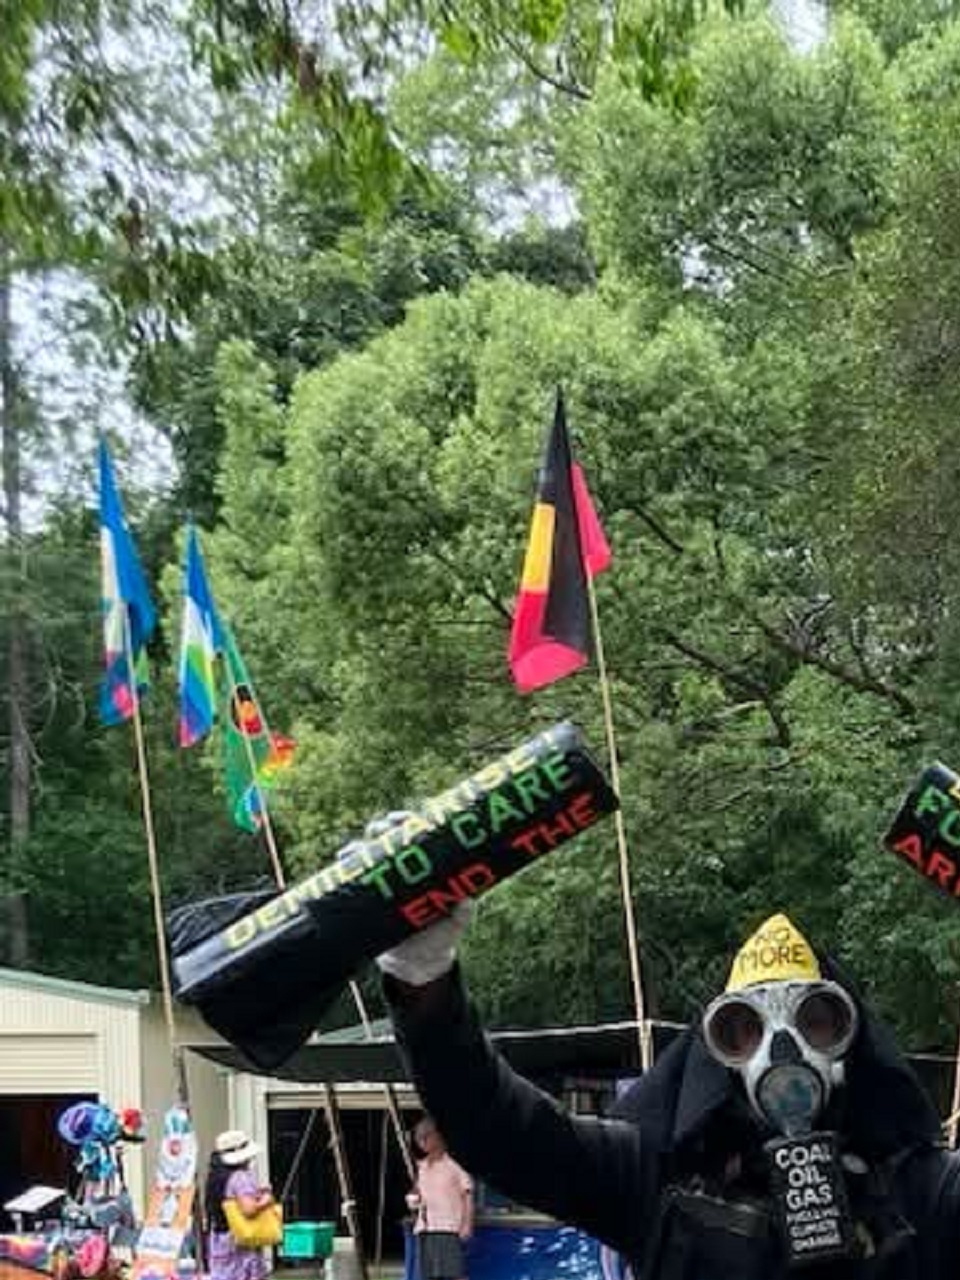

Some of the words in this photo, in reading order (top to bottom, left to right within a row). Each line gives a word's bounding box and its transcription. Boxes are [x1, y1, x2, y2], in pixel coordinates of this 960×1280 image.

[361, 846, 432, 898] TO
[450, 750, 575, 851] CARE
[402, 862, 496, 928] END
[511, 793, 597, 855] THE
[739, 942, 806, 974] MORE
[788, 1165, 828, 1187] OIL
[786, 1182, 833, 1210] GAS
